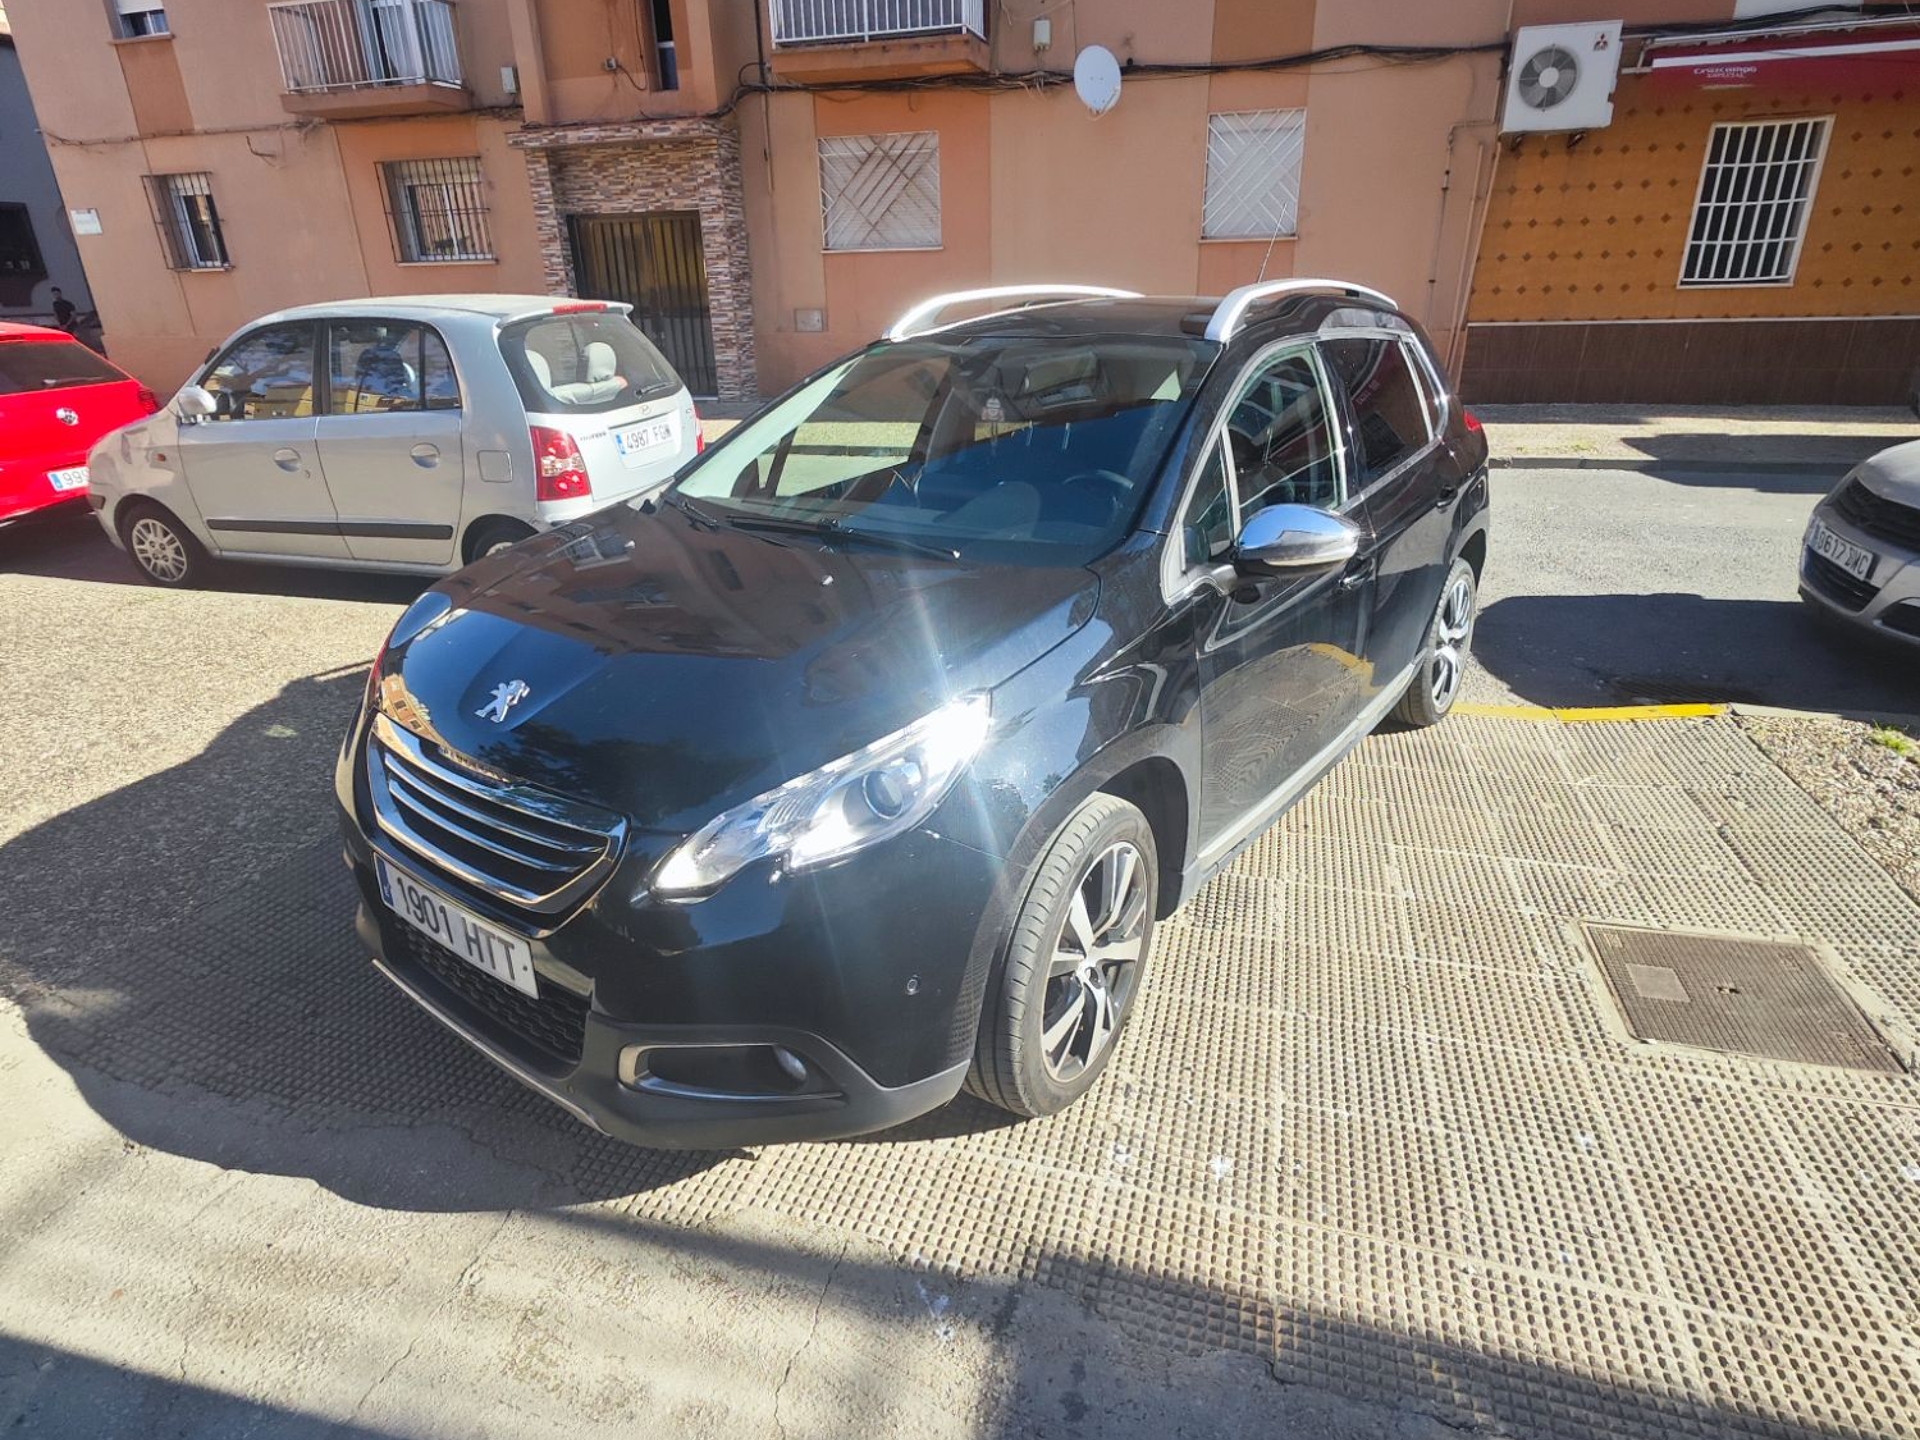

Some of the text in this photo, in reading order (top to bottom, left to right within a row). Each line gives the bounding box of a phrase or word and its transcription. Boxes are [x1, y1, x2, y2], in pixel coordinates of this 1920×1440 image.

[626, 429, 650, 449] 4987
[397, 876, 516, 981] 1901 HTT
